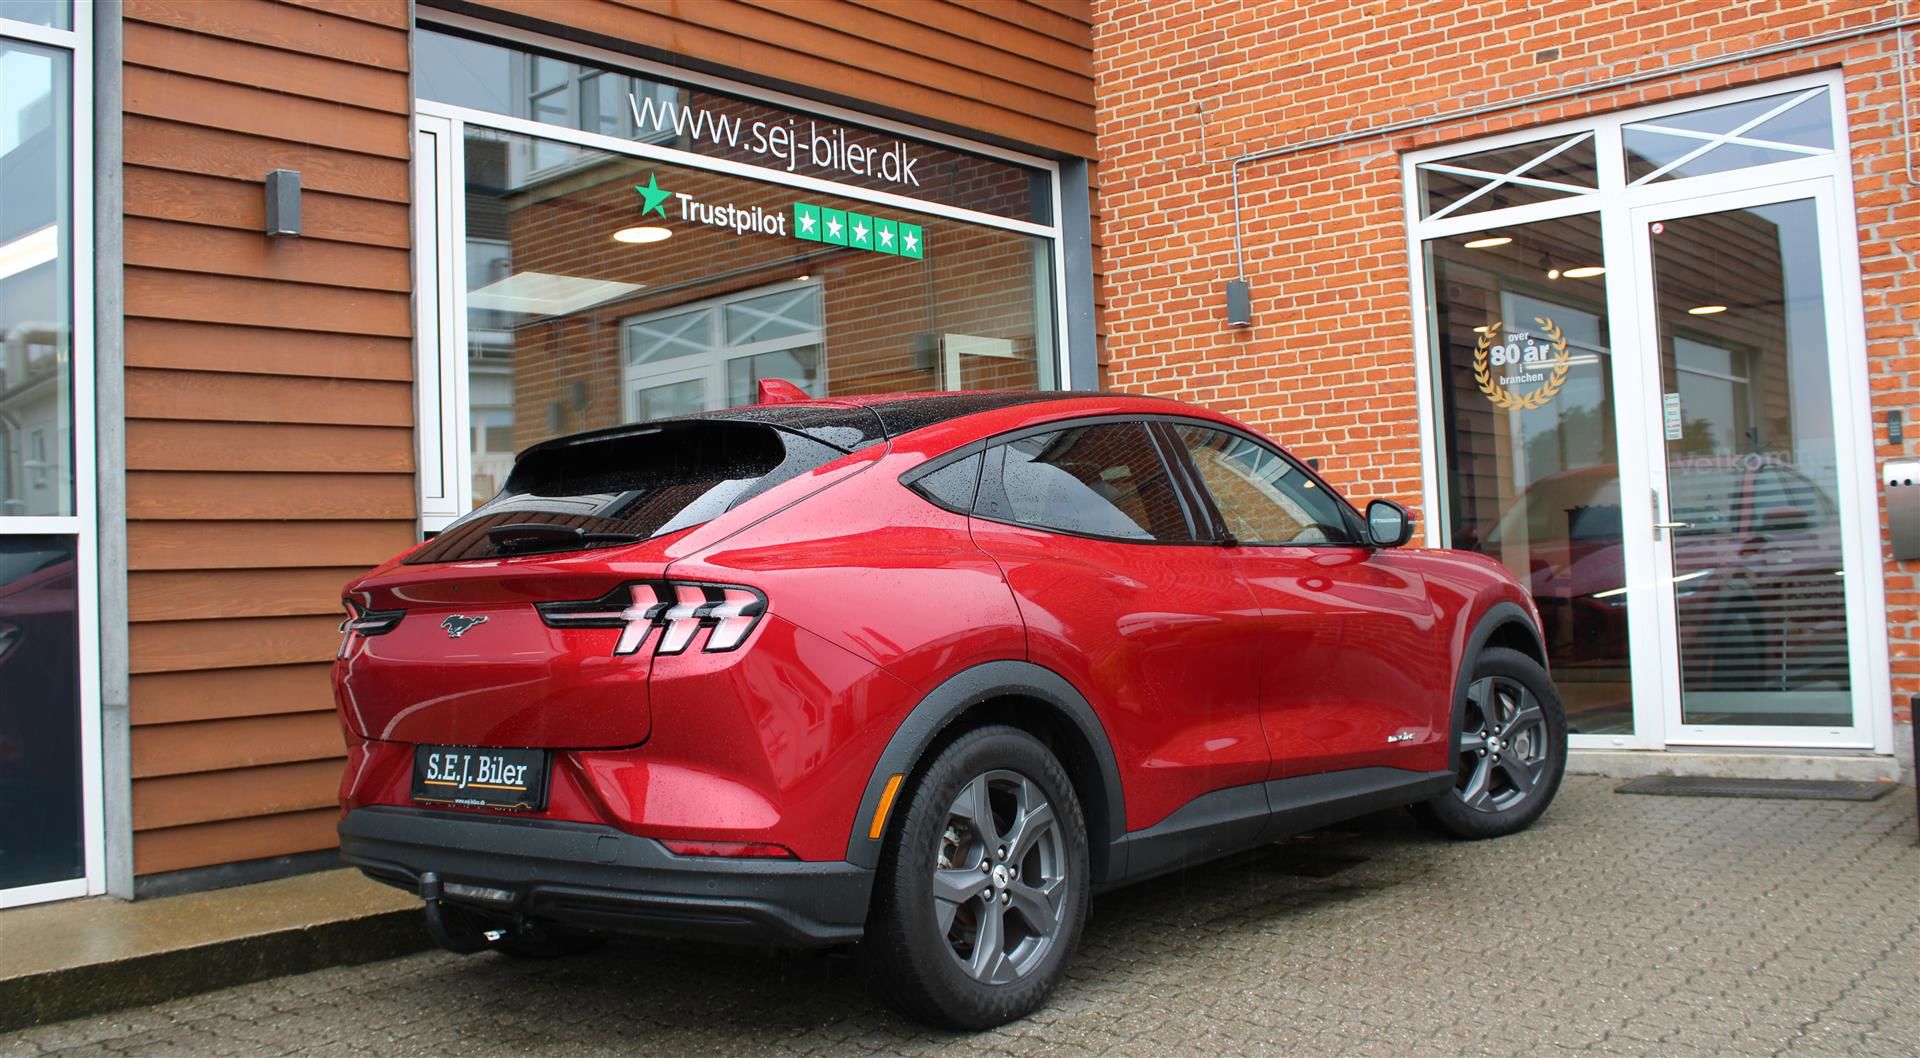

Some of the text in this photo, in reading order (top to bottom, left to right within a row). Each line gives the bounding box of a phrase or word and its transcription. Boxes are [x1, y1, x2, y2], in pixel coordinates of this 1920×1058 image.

[629, 93, 920, 186] www.sej-biler.dk
[676, 193, 786, 236] Trustpilot
[1508, 332, 1528, 342] over
[1490, 340, 1549, 366] 80 år
[1500, 373, 1543, 385] branchen
[427, 753, 527, 789] S.E.J. Biler
